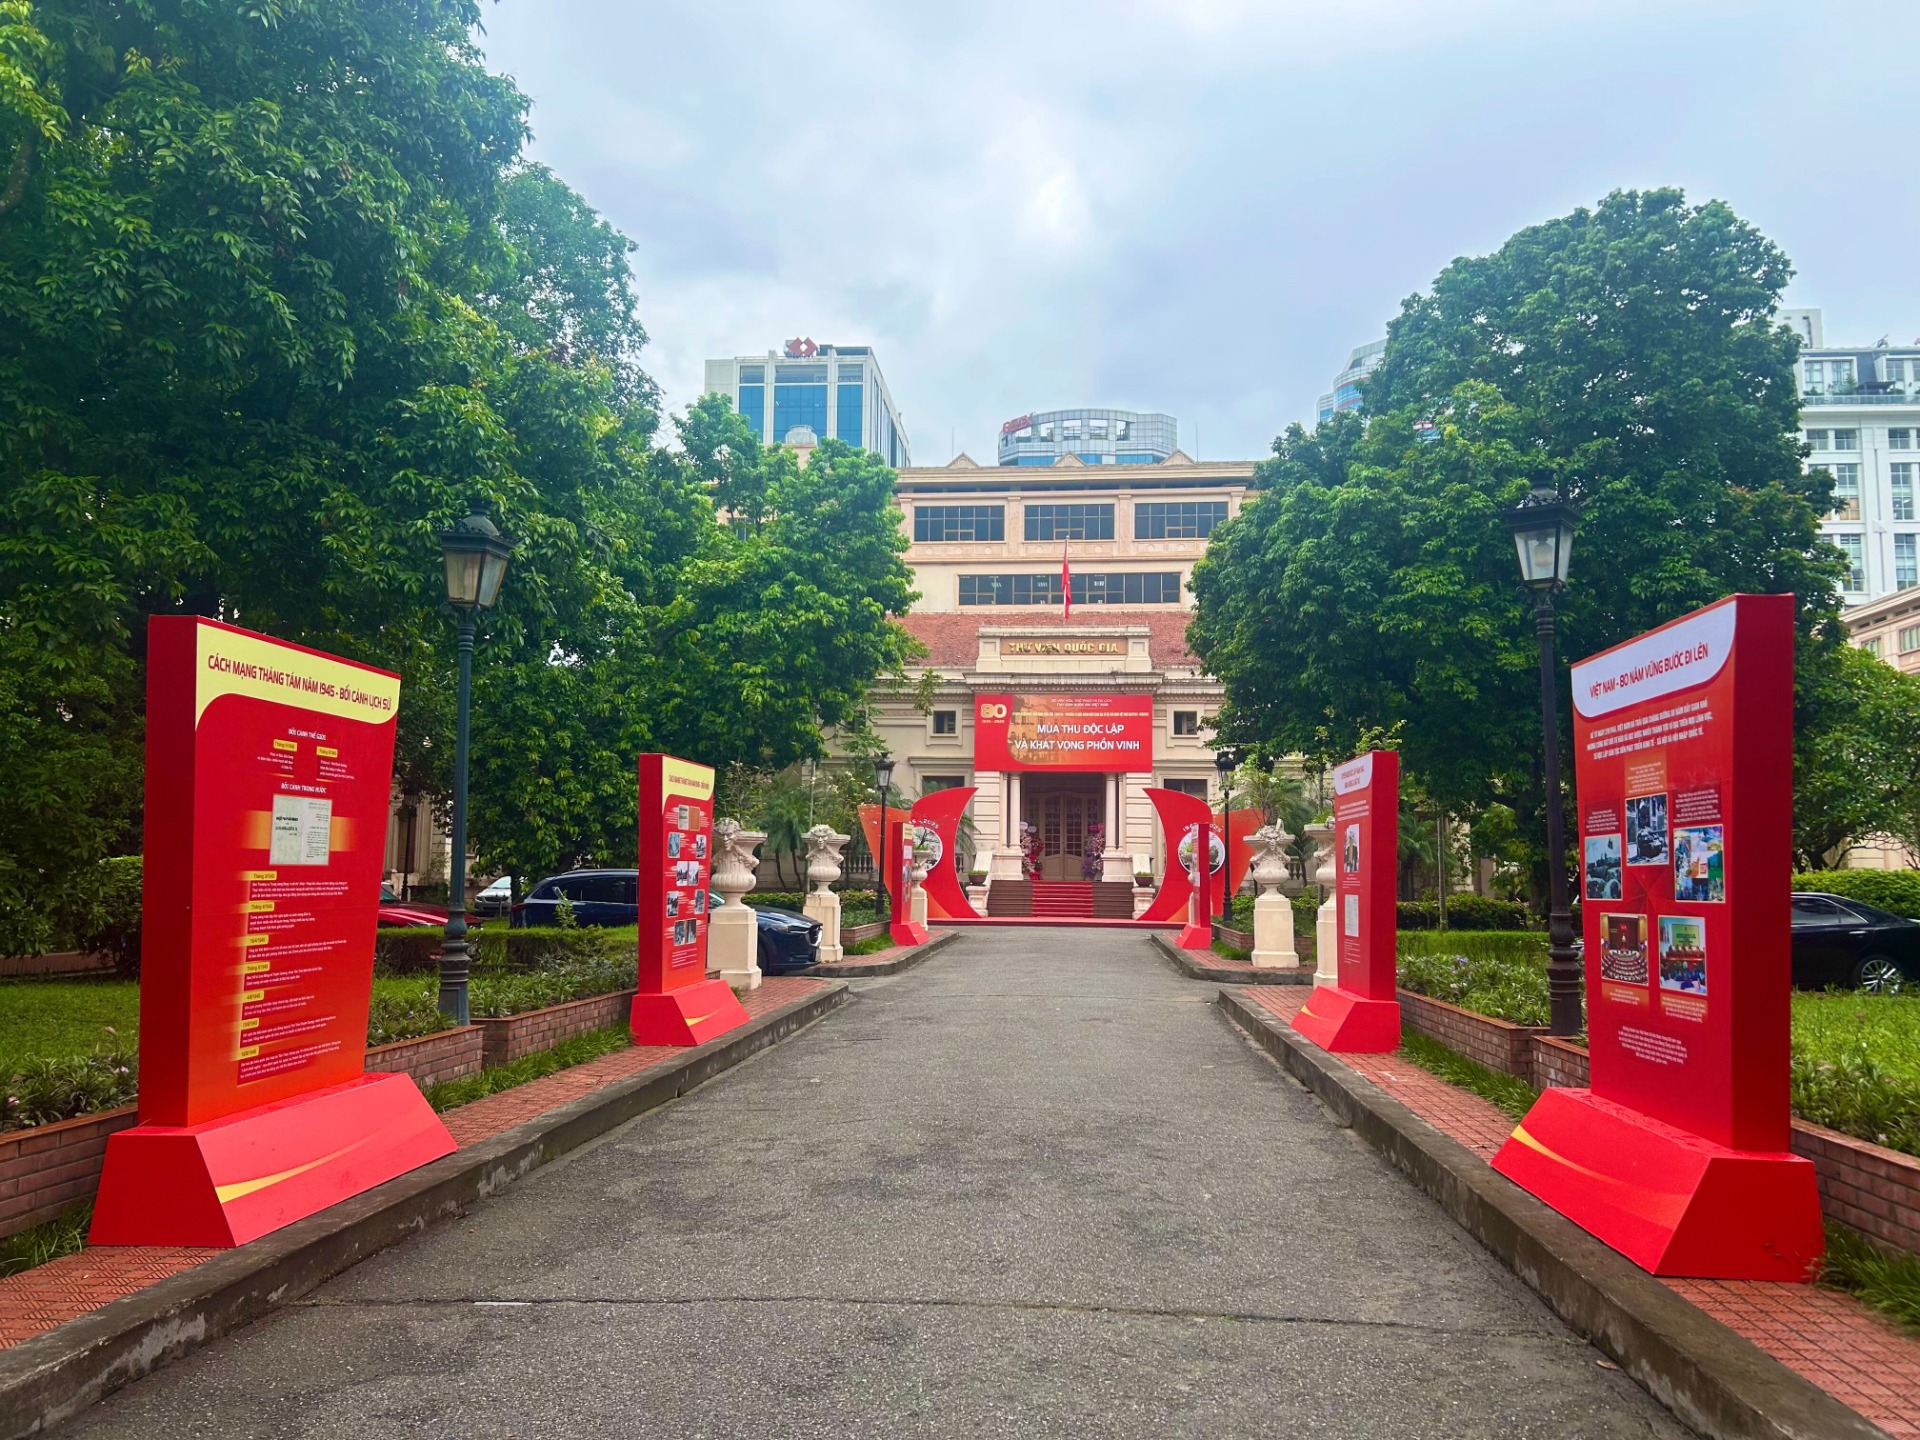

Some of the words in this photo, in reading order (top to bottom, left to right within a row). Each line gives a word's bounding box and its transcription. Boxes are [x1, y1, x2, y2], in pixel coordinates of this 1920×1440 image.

[1009, 642, 1033, 652] THƯ
[1035, 641, 1060, 654] VIỆN
[1064, 641, 1094, 653] QUỐC
[1098, 643, 1118, 653] GIA
[1589, 682, 1602, 699] VIỆT
[1602, 678, 1616, 694] NAM
[1619, 673, 1629, 688] 80
[1629, 666, 1644, 684] NĂM
[1644, 660, 1664, 679] VỮNG
[1664, 651, 1684, 672] BƯỚC
[1684, 649, 1693, 664] ĐI
[1694, 642, 1709, 661] LÊN
[208, 653, 231, 673] CÁCH
[232, 660, 257, 680] MẠNG
[258, 666, 285, 685] THÁNG
[285, 672, 301, 690] TÁM
[302, 677, 318, 694] NĂM
[319, 682, 335, 697] 1945
[339, 684, 350, 701] BỐI
[351, 688, 369, 705] CẢNH
[369, 696, 382, 710] LỊCH
[980, 703, 1007, 719] 80
[1037, 722, 1060, 734] MÙA
[1061, 724, 1081, 733] THU
[1083, 722, 1104, 735] ĐỘC
[1105, 722, 1124, 736] LẬP
[1014, 738, 1028, 749] VÀ
[1030, 738, 1055, 750] KHÁT
[1056, 740, 1084, 751] VỌNG
[1086, 737, 1114, 750] PHỒN
[1116, 740, 1140, 750] VINH
